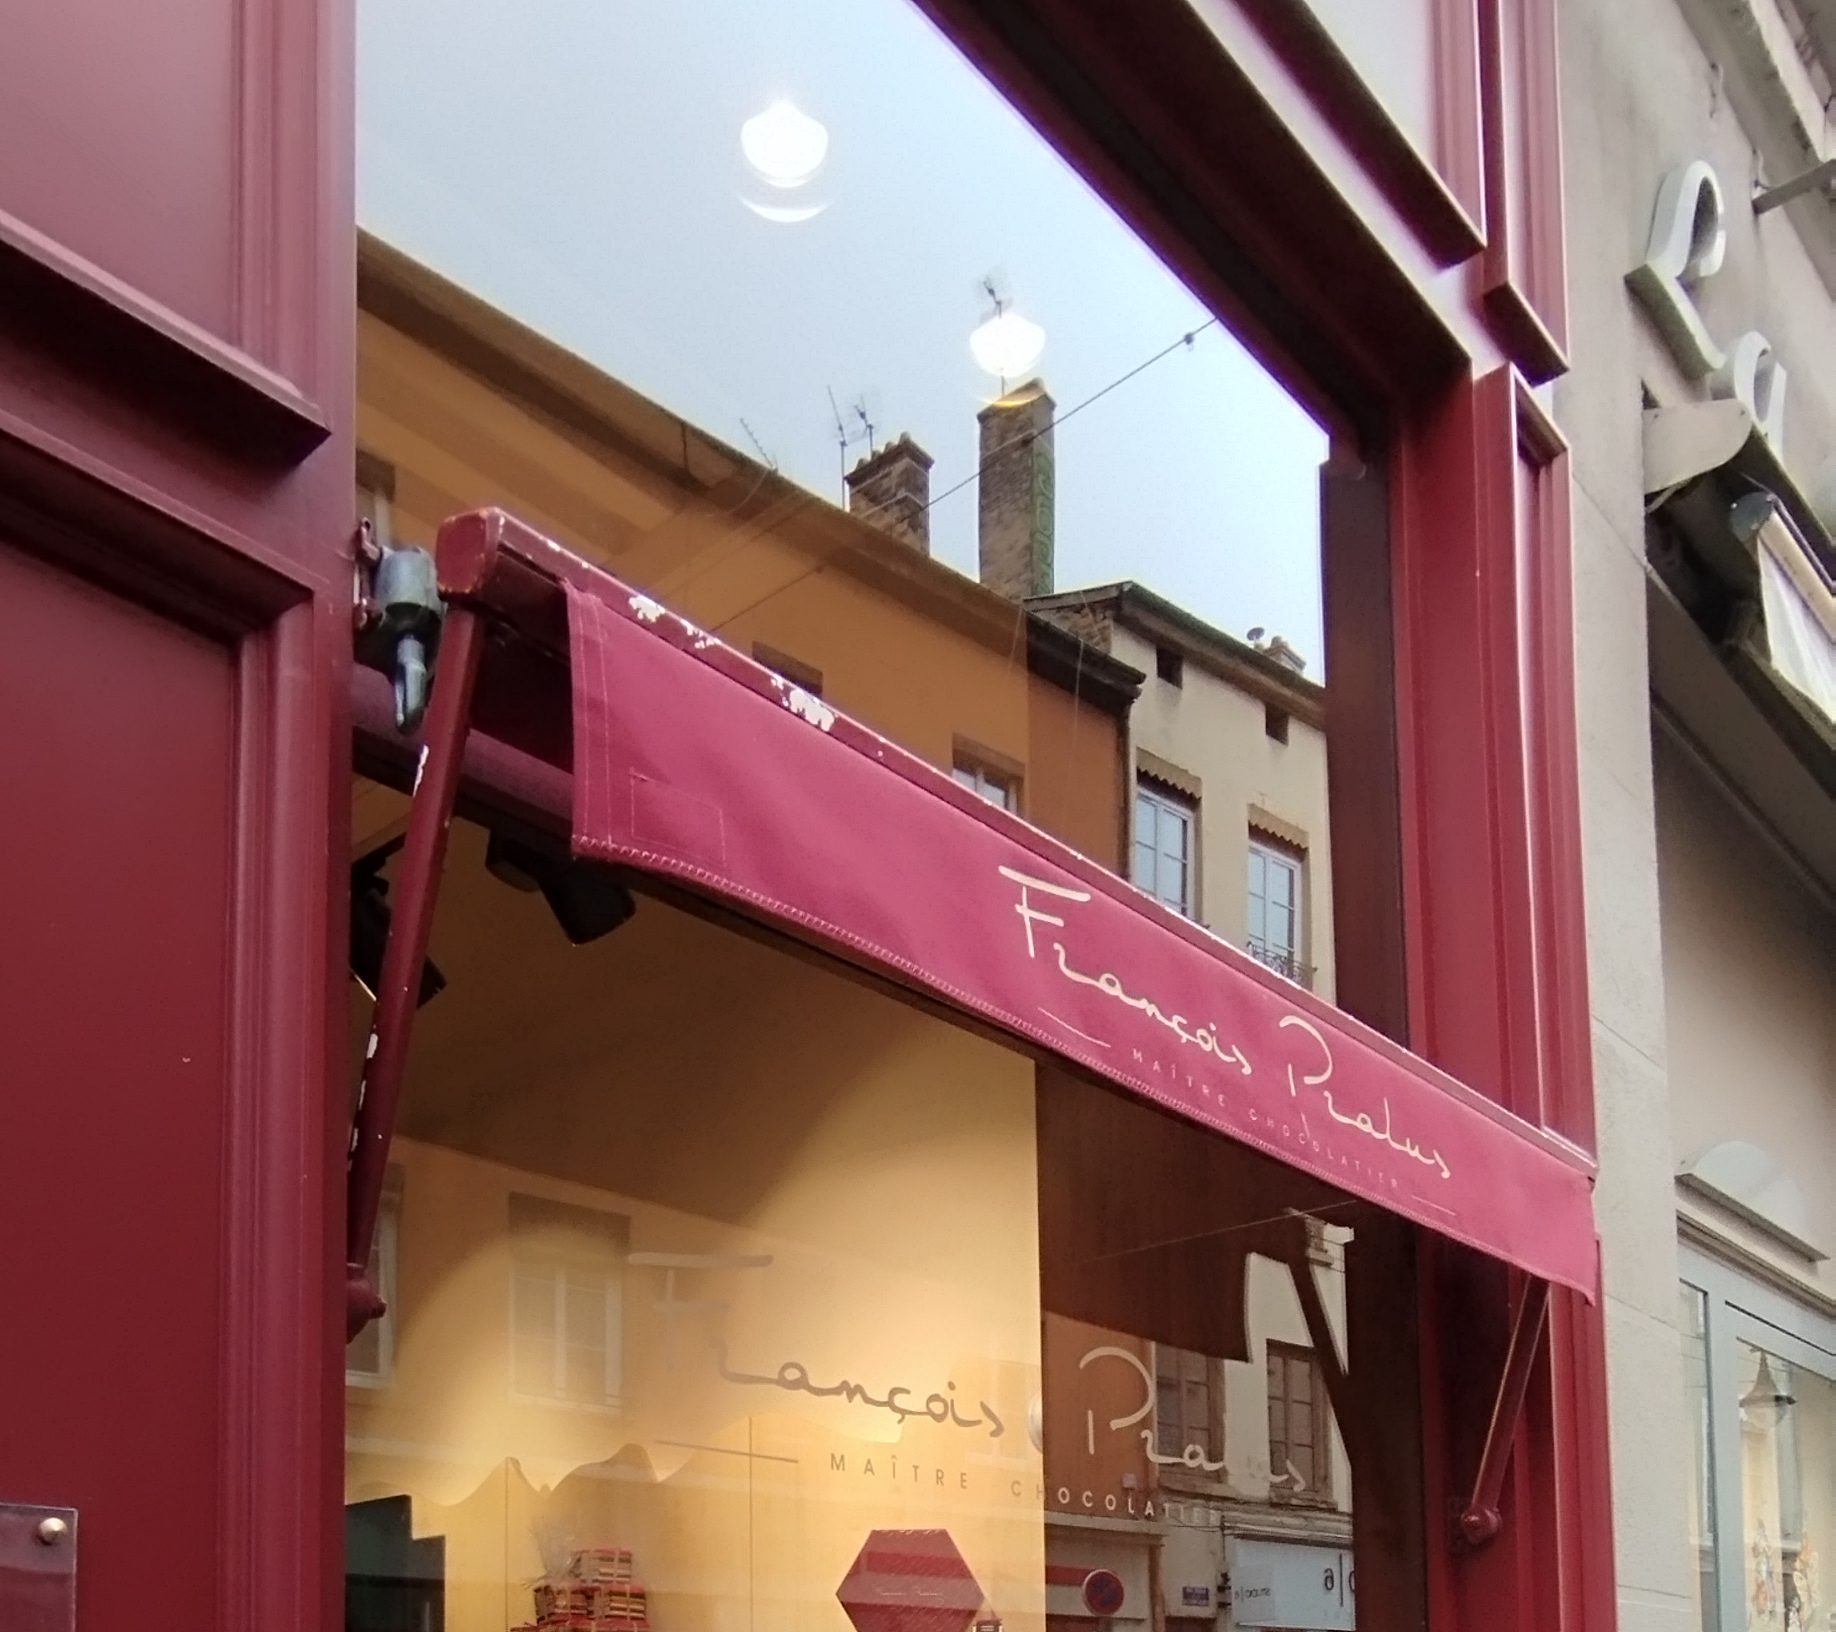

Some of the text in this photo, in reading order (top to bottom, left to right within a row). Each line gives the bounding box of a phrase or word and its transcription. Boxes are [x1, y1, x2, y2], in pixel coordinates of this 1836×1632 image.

[999, 865, 1450, 1179] François Pralus
[1132, 1048, 1398, 1188] MAÎTRE CHOCOLATIER
[830, 1453, 968, 1489] MAÎTRE
